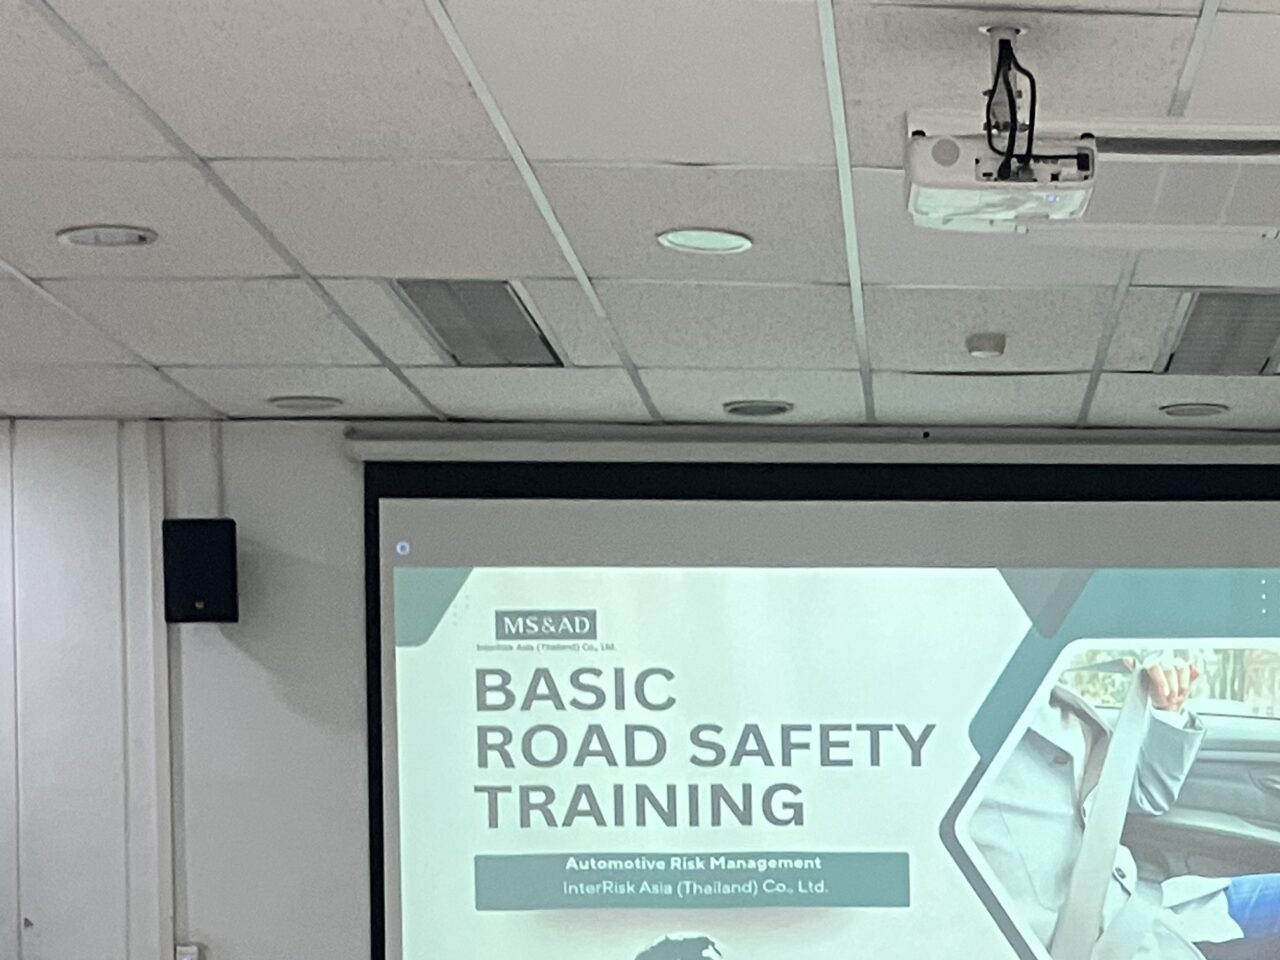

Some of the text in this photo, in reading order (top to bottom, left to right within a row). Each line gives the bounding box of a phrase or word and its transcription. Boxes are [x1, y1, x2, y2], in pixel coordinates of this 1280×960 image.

[503, 616, 590, 635] MS&AD
[474, 667, 677, 712] BASIC
[476, 723, 937, 769] ROAD SAFETY
[474, 783, 805, 829] TRAINING
[565, 855, 823, 873] Automotive Risk Management
[563, 880, 636, 895] InterRisk
[639, 880, 673, 895] Asia
[676, 880, 759, 898] (Thailand)
[798, 879, 829, 894] Ltd.
